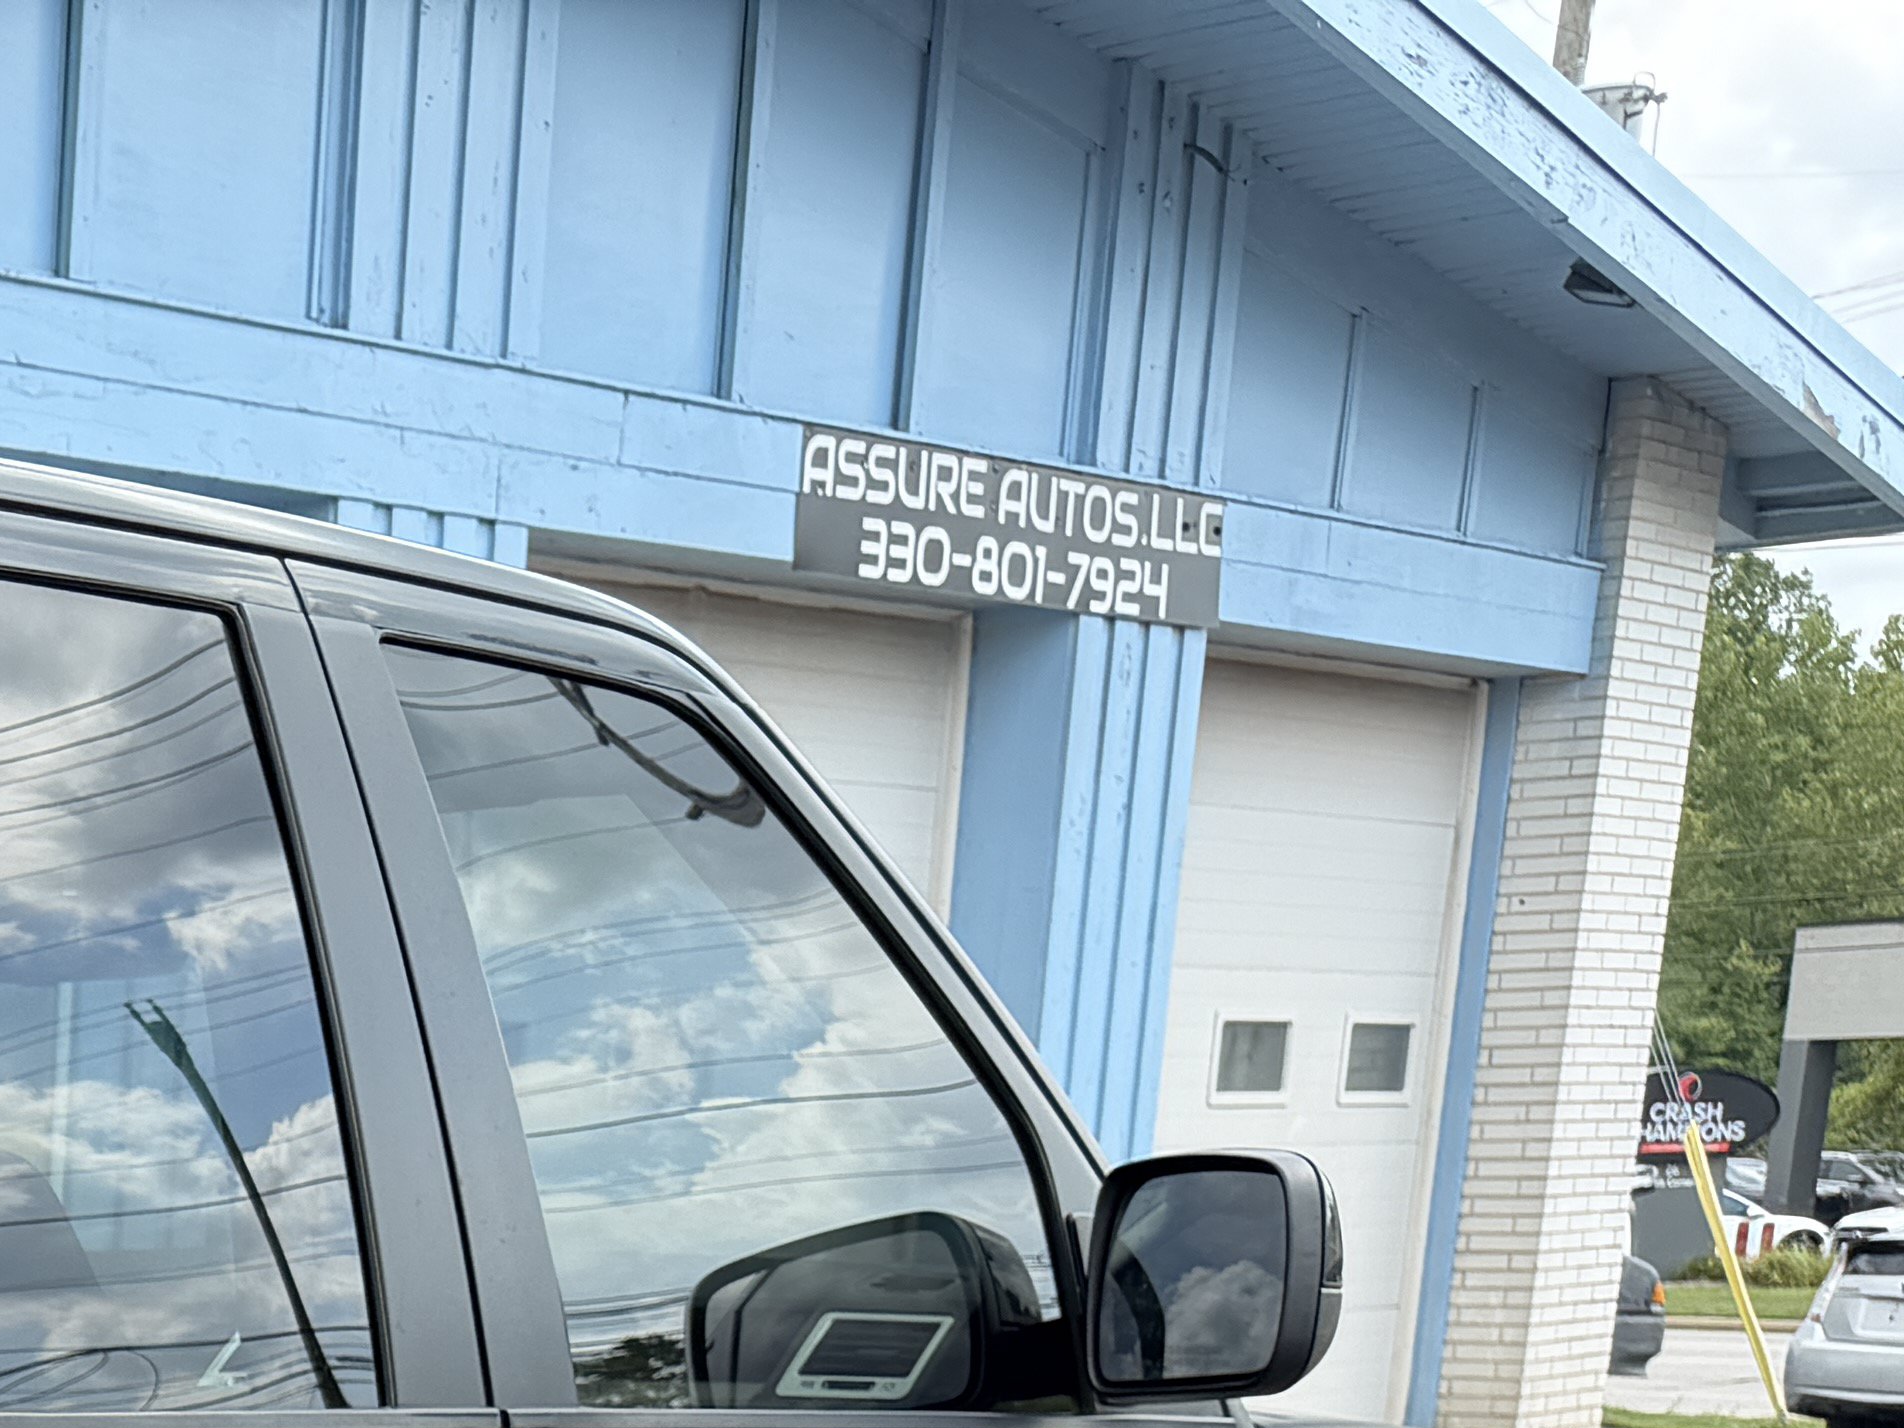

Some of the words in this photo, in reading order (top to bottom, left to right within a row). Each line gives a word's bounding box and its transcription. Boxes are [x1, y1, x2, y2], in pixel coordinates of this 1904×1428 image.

[802, 433, 989, 520] ASSURE
[858, 516, 1170, 620] 330-801-7924
[1641, 1119, 1746, 1142] HAMPONS
[1649, 1101, 1724, 1122] CRASH
